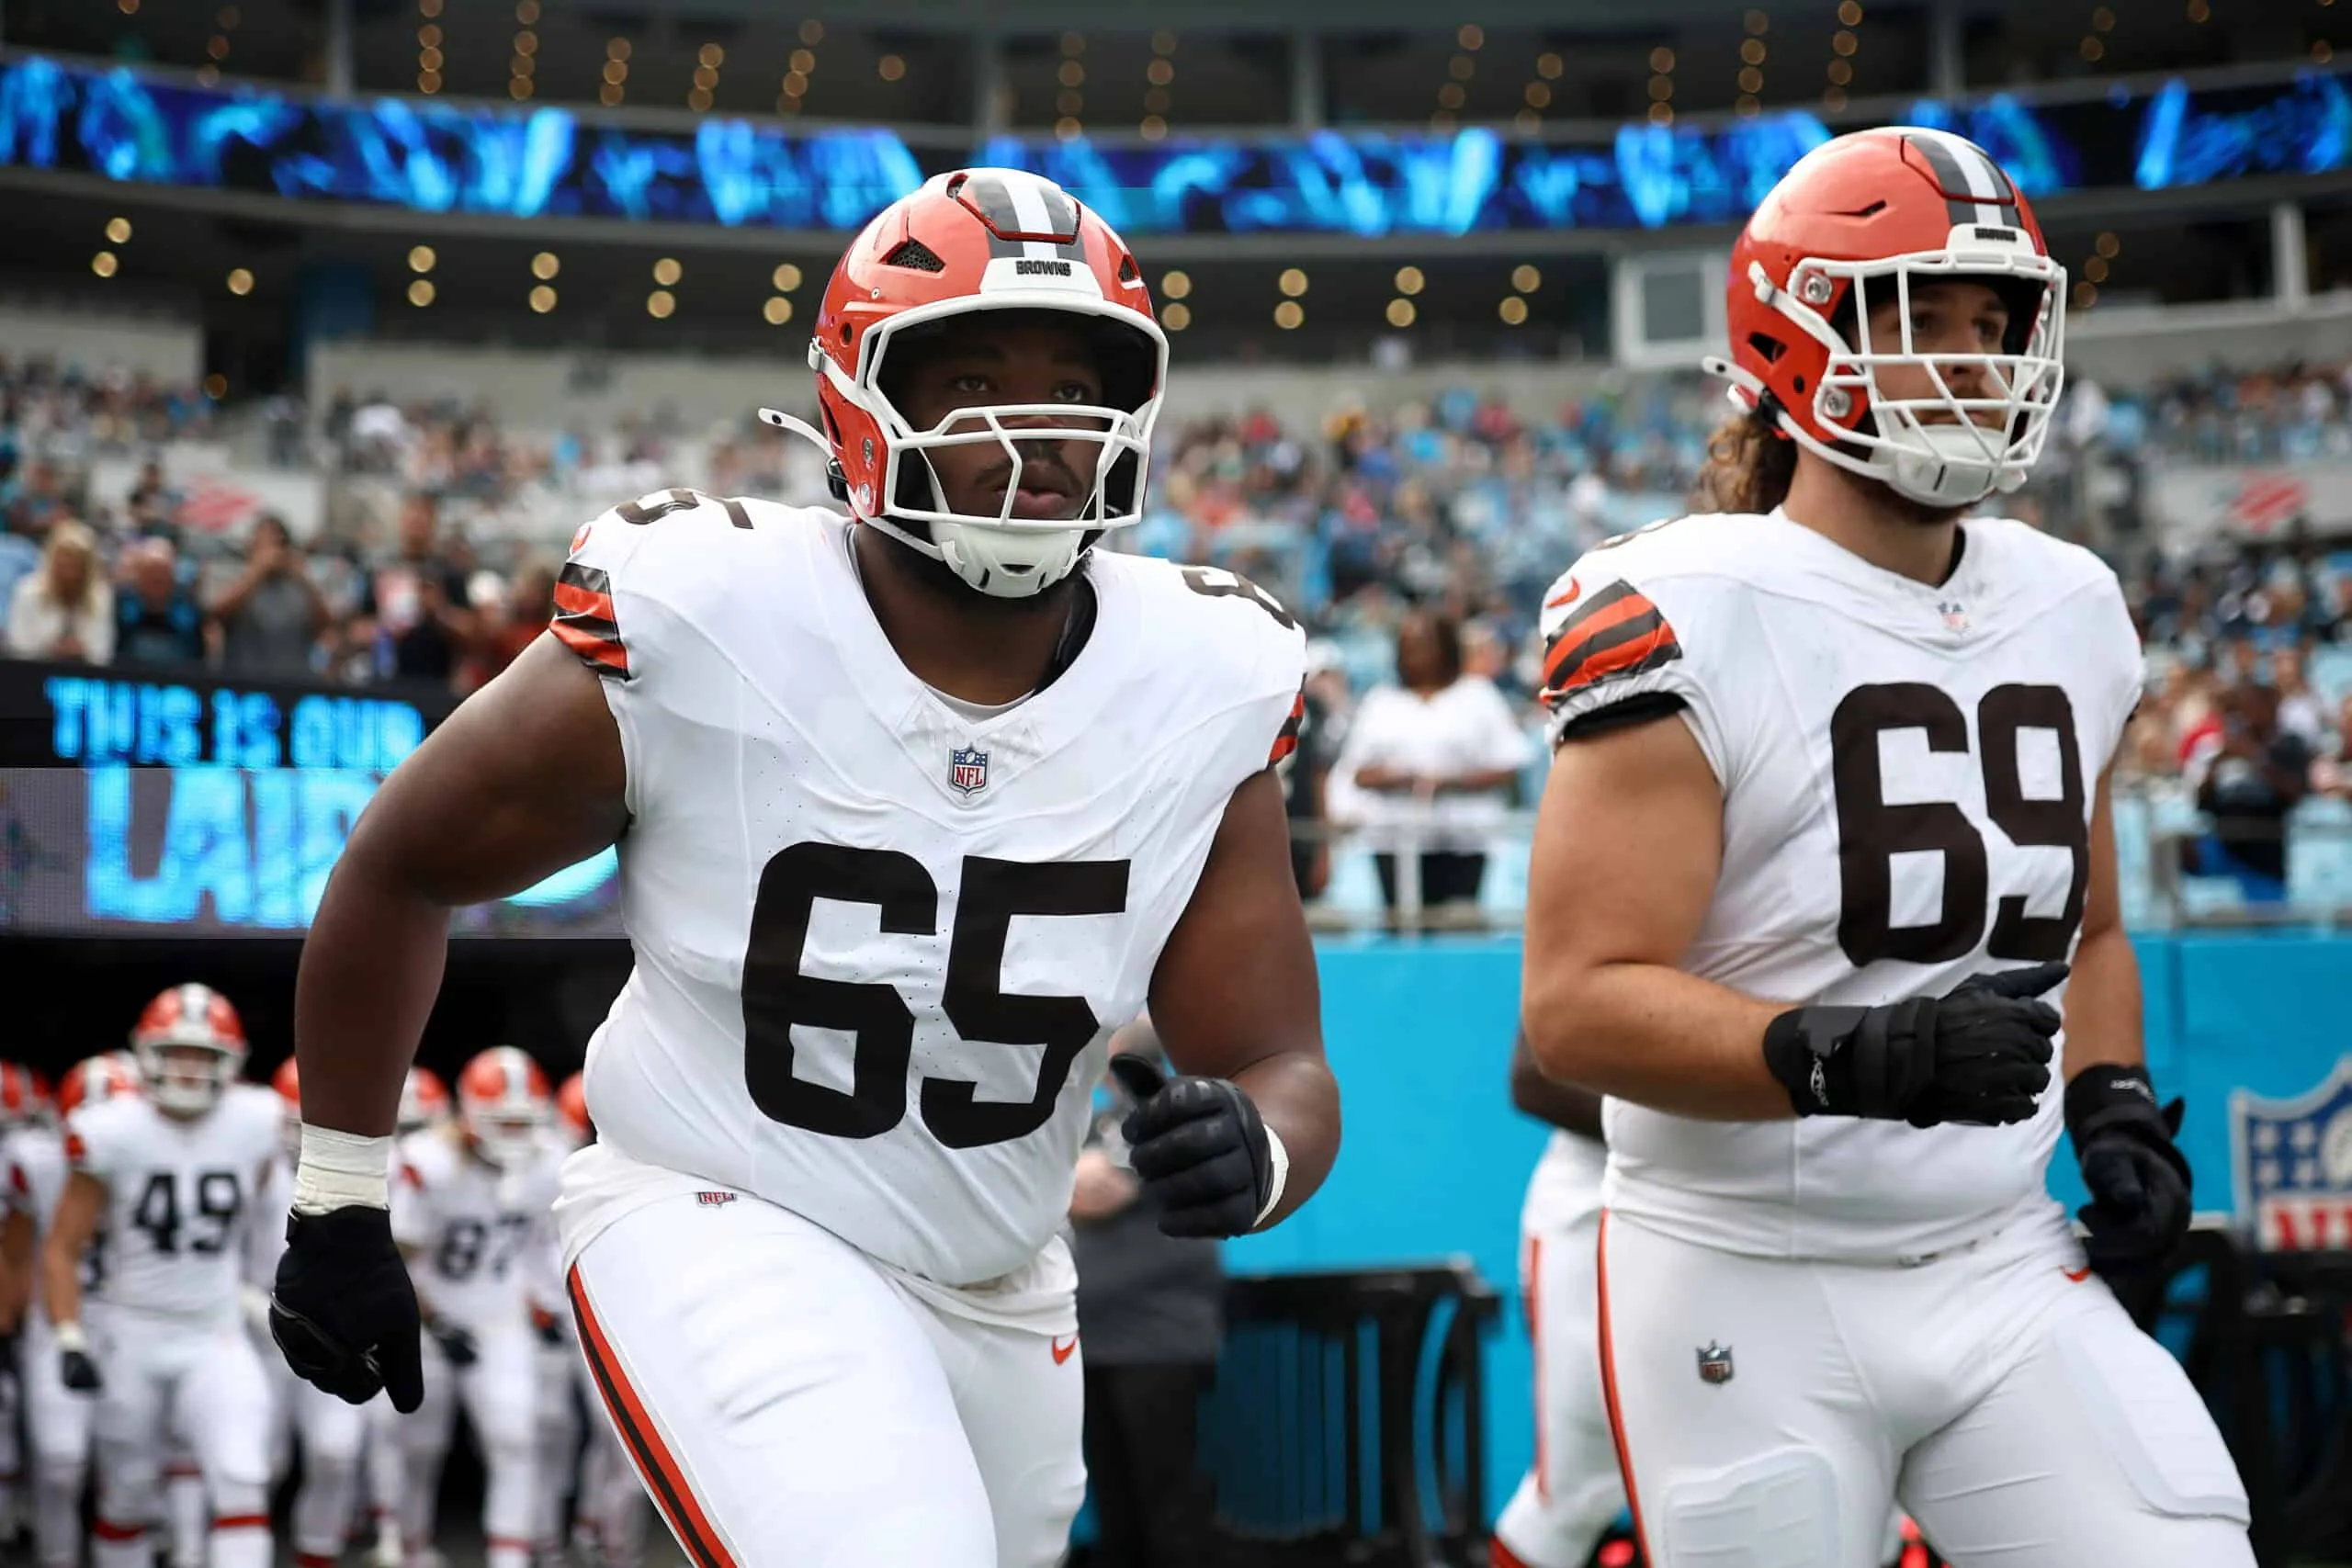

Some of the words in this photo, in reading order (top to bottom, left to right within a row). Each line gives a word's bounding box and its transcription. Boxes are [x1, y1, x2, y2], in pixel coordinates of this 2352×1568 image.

[1016, 260, 1071, 276] BROWNS
[44, 676, 201, 766] THIS
[211, 688, 282, 767] IS
[956, 766, 983, 787] NFL
[1830, 682, 2089, 967] 69
[741, 841, 1131, 1149] 65
[133, 1169, 243, 1255] 49
